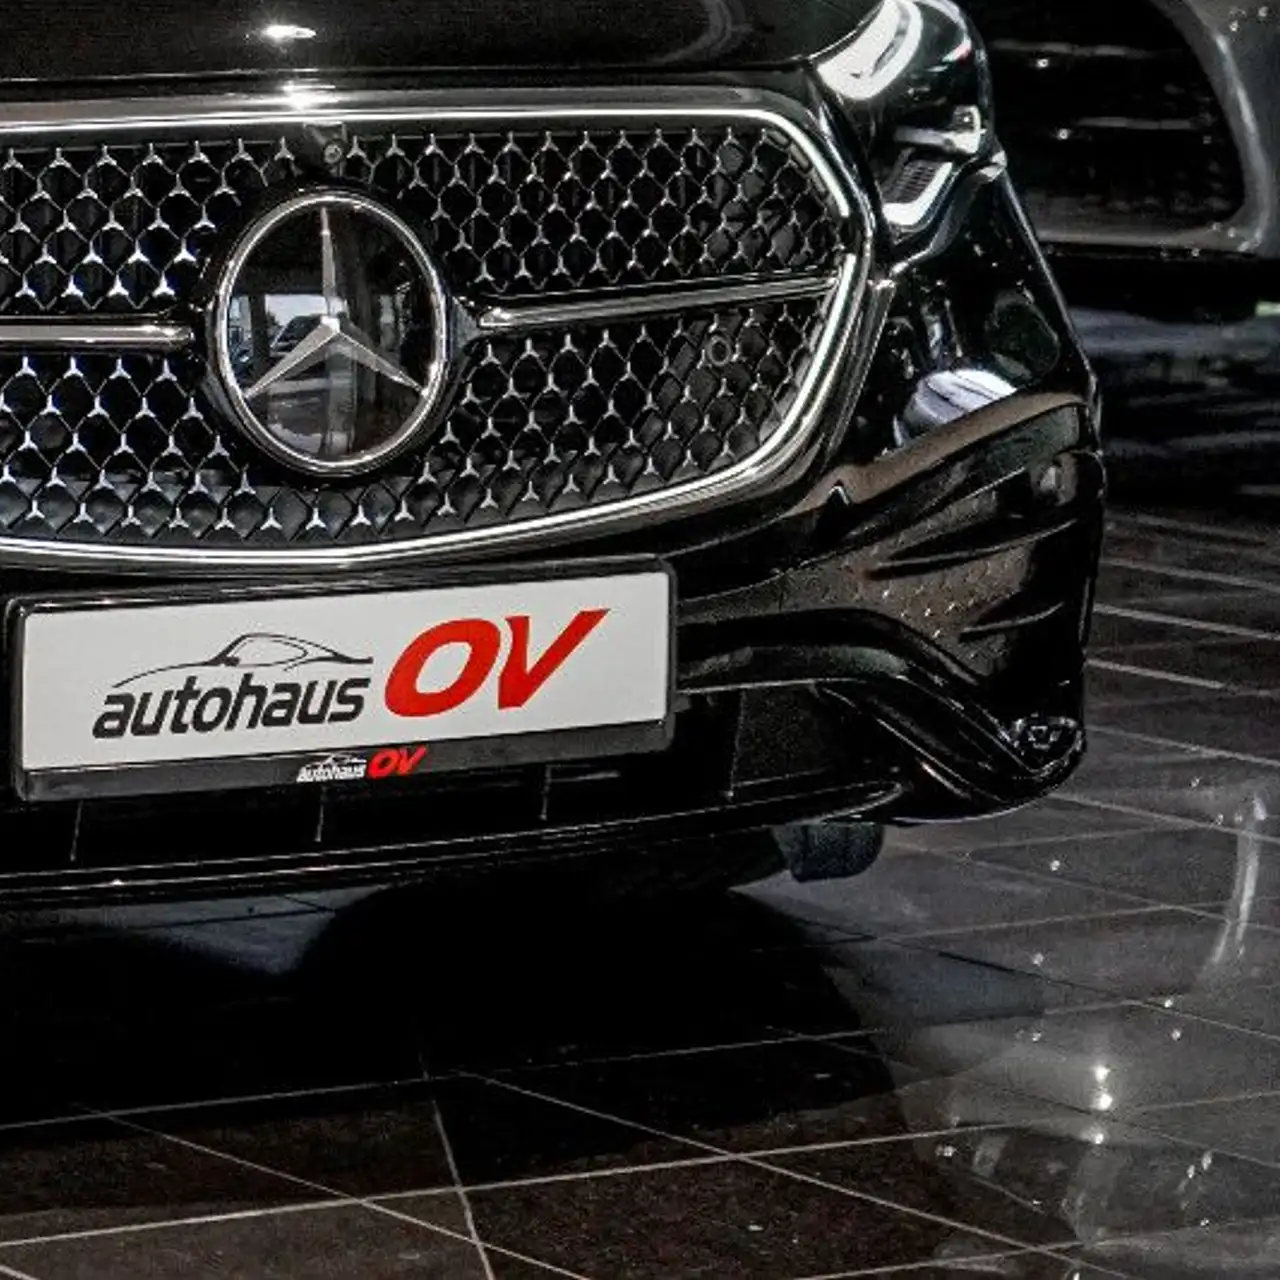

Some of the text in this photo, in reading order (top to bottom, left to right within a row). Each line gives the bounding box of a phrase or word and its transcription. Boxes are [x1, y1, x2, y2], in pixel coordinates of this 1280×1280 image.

[92, 607, 611, 739] autohaus OV
[296, 745, 427, 782] autohaus OV
